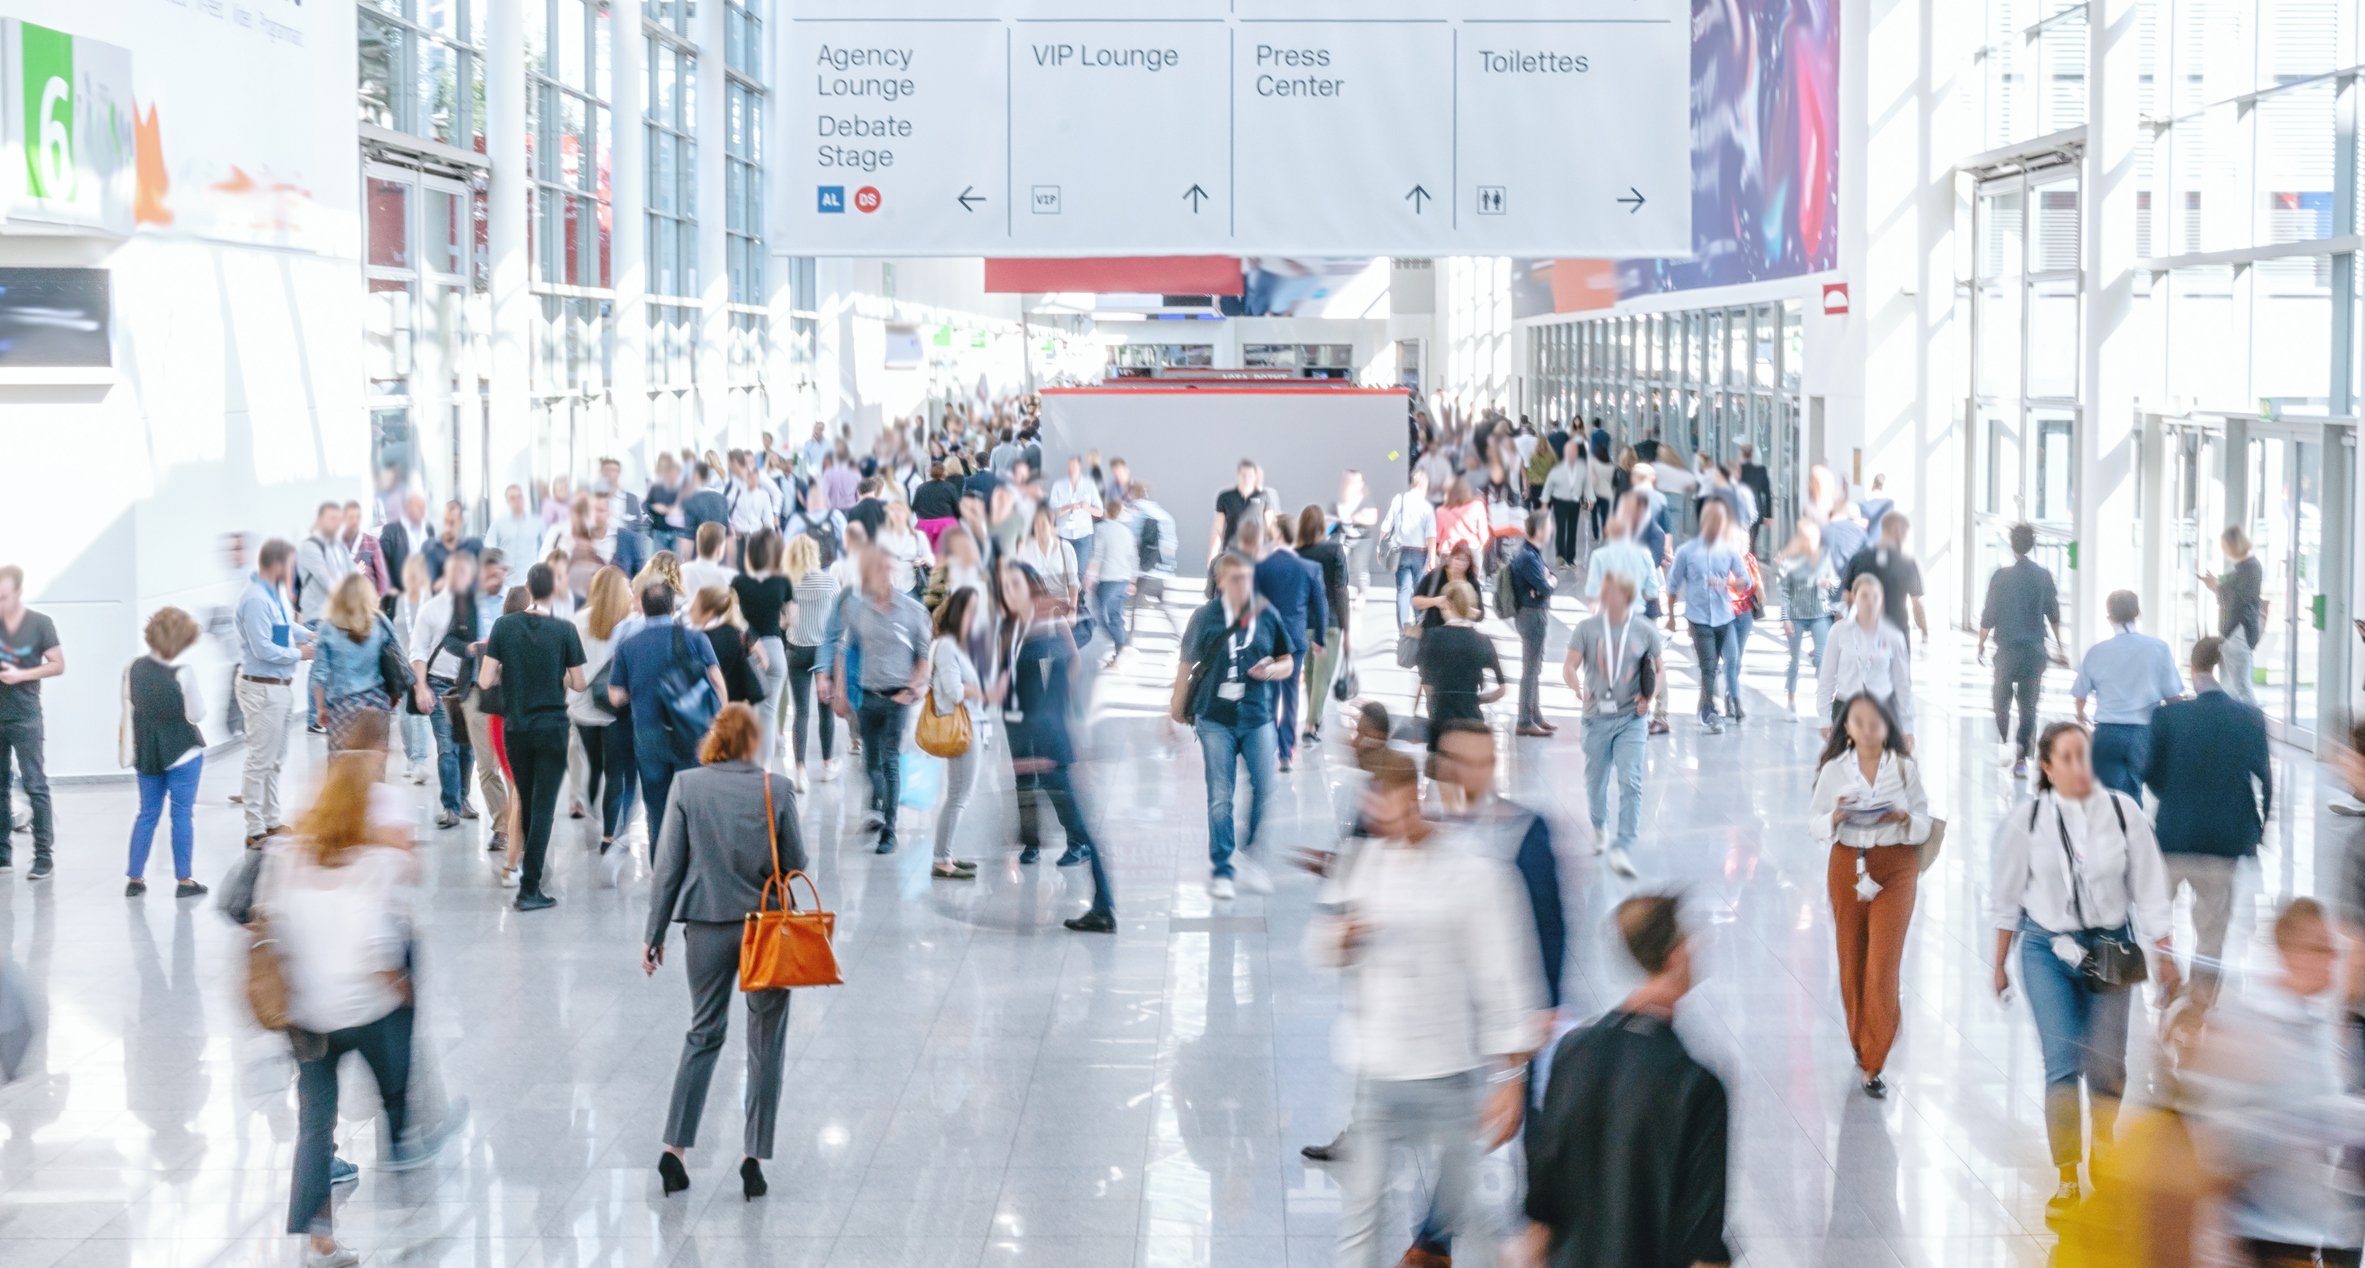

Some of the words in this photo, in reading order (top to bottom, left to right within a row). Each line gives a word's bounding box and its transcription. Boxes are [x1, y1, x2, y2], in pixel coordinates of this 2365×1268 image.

[816, 43, 914, 72] Agency
[1031, 43, 1074, 67] VIP
[1081, 43, 1180, 73] Lounge
[1256, 44, 1331, 68] Press
[1478, 49, 1589, 74] Toilettes
[817, 74, 915, 102] Lounge
[1255, 73, 1345, 98] Center
[39, 74, 74, 202] 6
[817, 113, 913, 138] Debate
[817, 144, 894, 173] Stage
[821, 192, 841, 207] AL
[858, 192, 878, 207] DS
[1035, 194, 1057, 206] VIP
